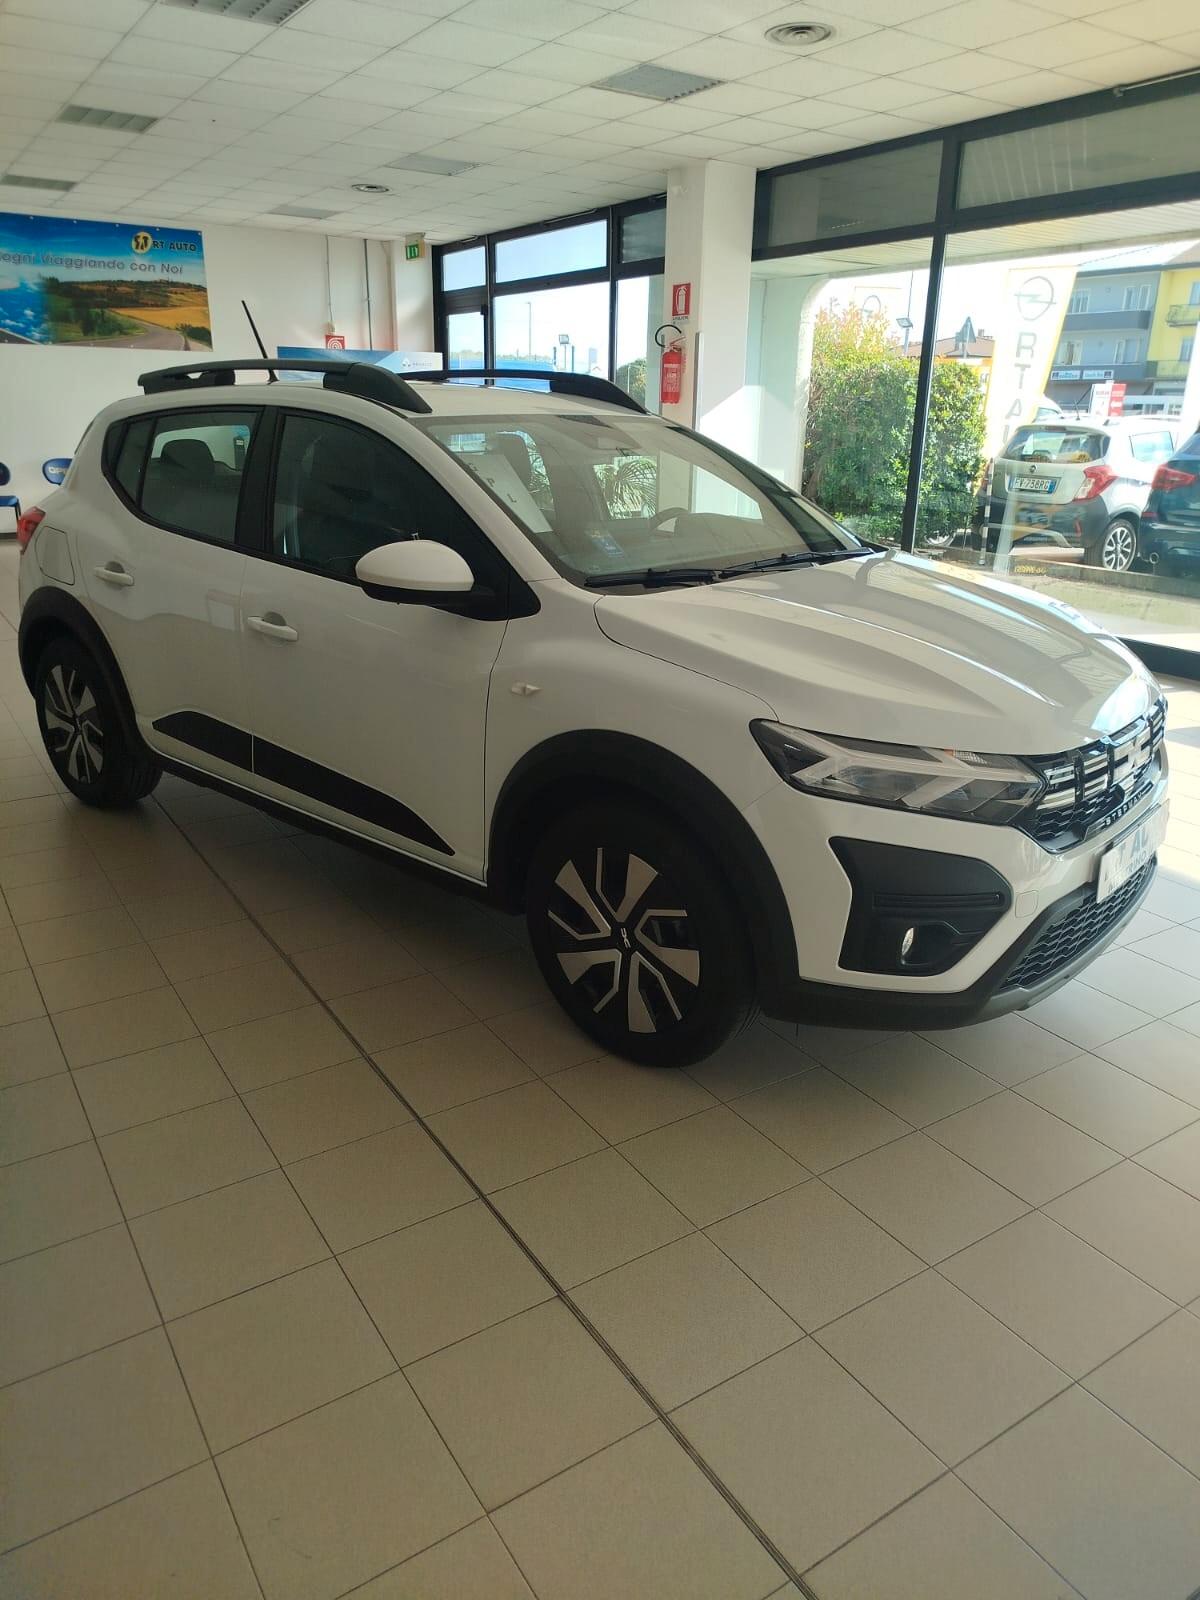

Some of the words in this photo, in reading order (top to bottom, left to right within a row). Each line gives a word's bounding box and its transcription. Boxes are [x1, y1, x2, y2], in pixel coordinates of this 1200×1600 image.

[169, 242, 197, 252] AUTO
[130, 262, 156, 273] con
[160, 263, 183, 274] Noi
[1105, 790, 1143, 827] STEPWAY
